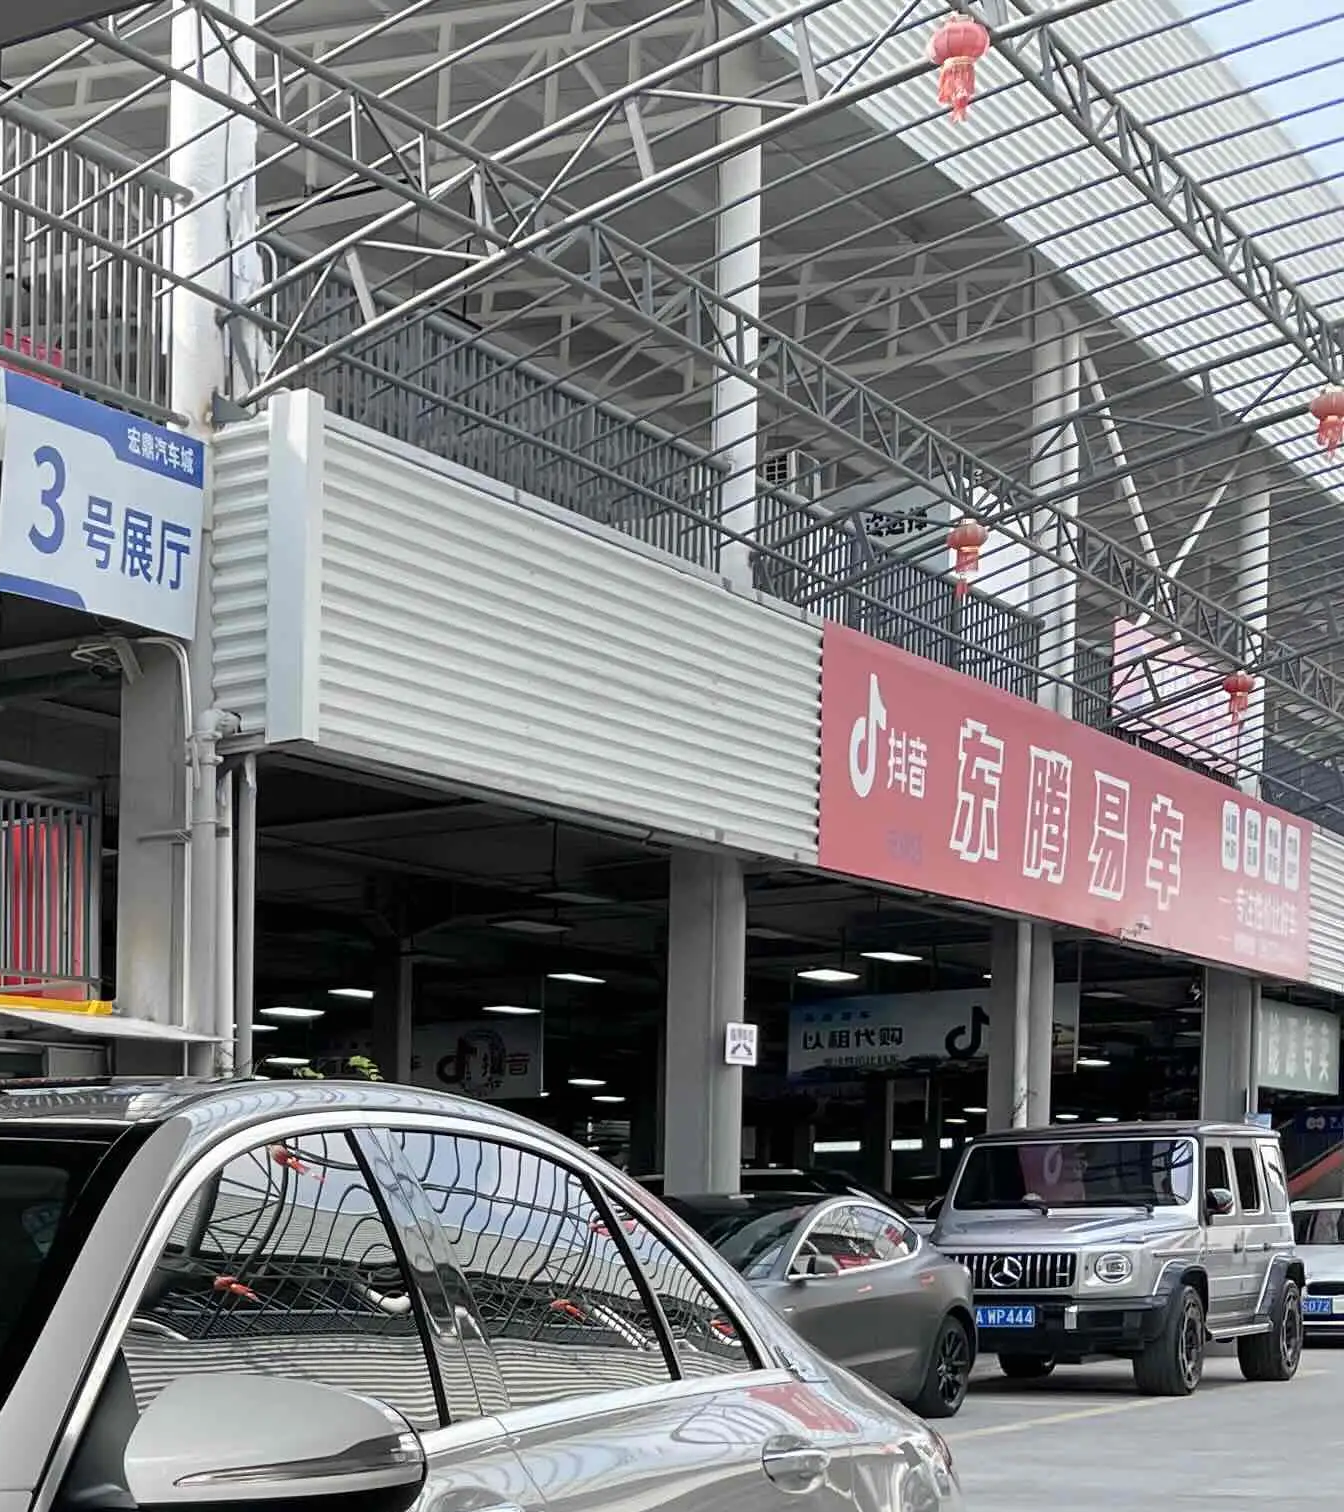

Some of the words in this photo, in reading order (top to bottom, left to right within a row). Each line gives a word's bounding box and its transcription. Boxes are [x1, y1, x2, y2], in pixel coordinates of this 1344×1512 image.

[127, 428, 195, 475] 宏鼎汽车城
[29, 445, 191, 590] 3号展厅
[887, 728, 928, 801] 抖音
[802, 1027, 904, 1050] 以租代购
